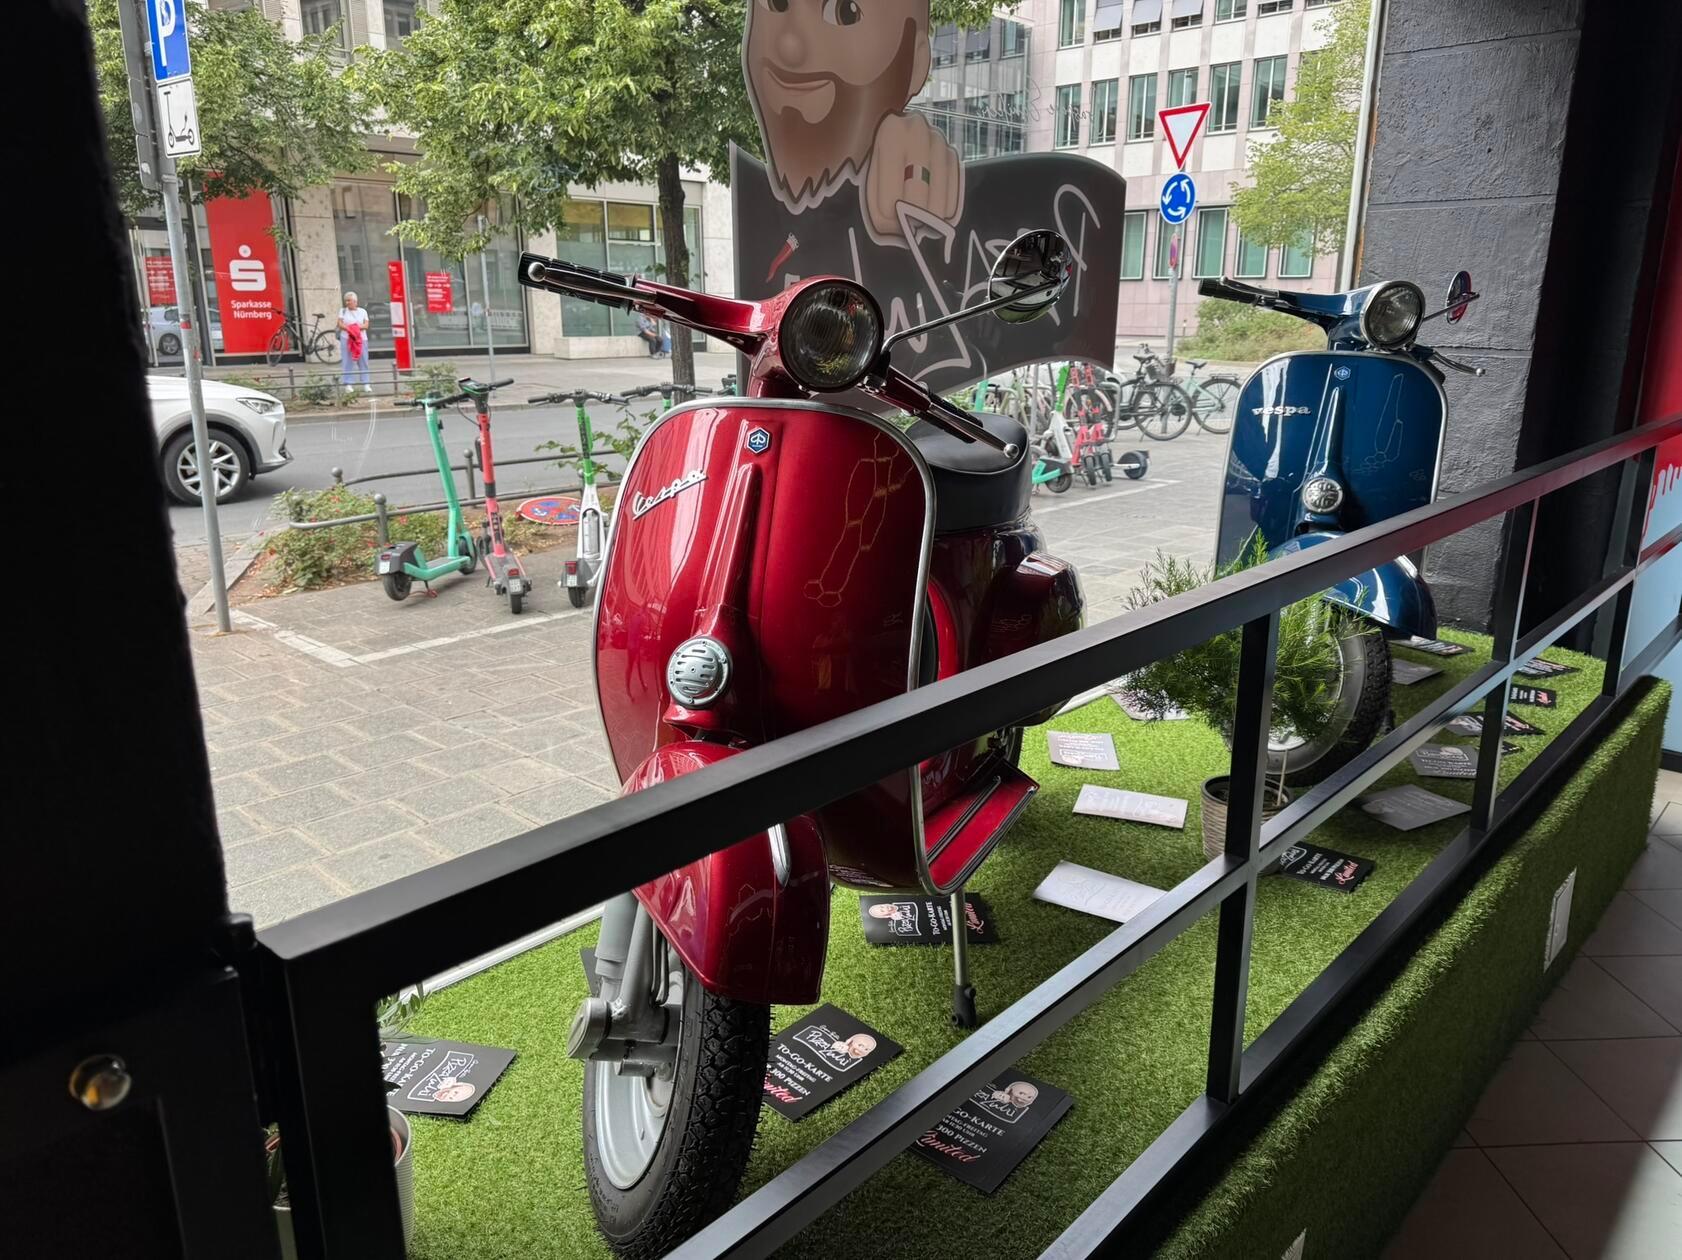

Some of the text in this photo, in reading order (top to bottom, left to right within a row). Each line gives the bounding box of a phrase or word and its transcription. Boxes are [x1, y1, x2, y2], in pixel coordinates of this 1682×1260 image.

[154, 0, 176, 67] P
[230, 300, 272, 309] Sparkasse
[233, 310, 272, 320] Nürnberg
[1251, 406, 1312, 417] vespa
[632, 467, 707, 520] Vespa
[777, 1043, 833, 1082] TO-GO-KARTE
[784, 1077, 811, 1096] PIZZEN
[936, 1124, 988, 1153] 300 PIZZEN
